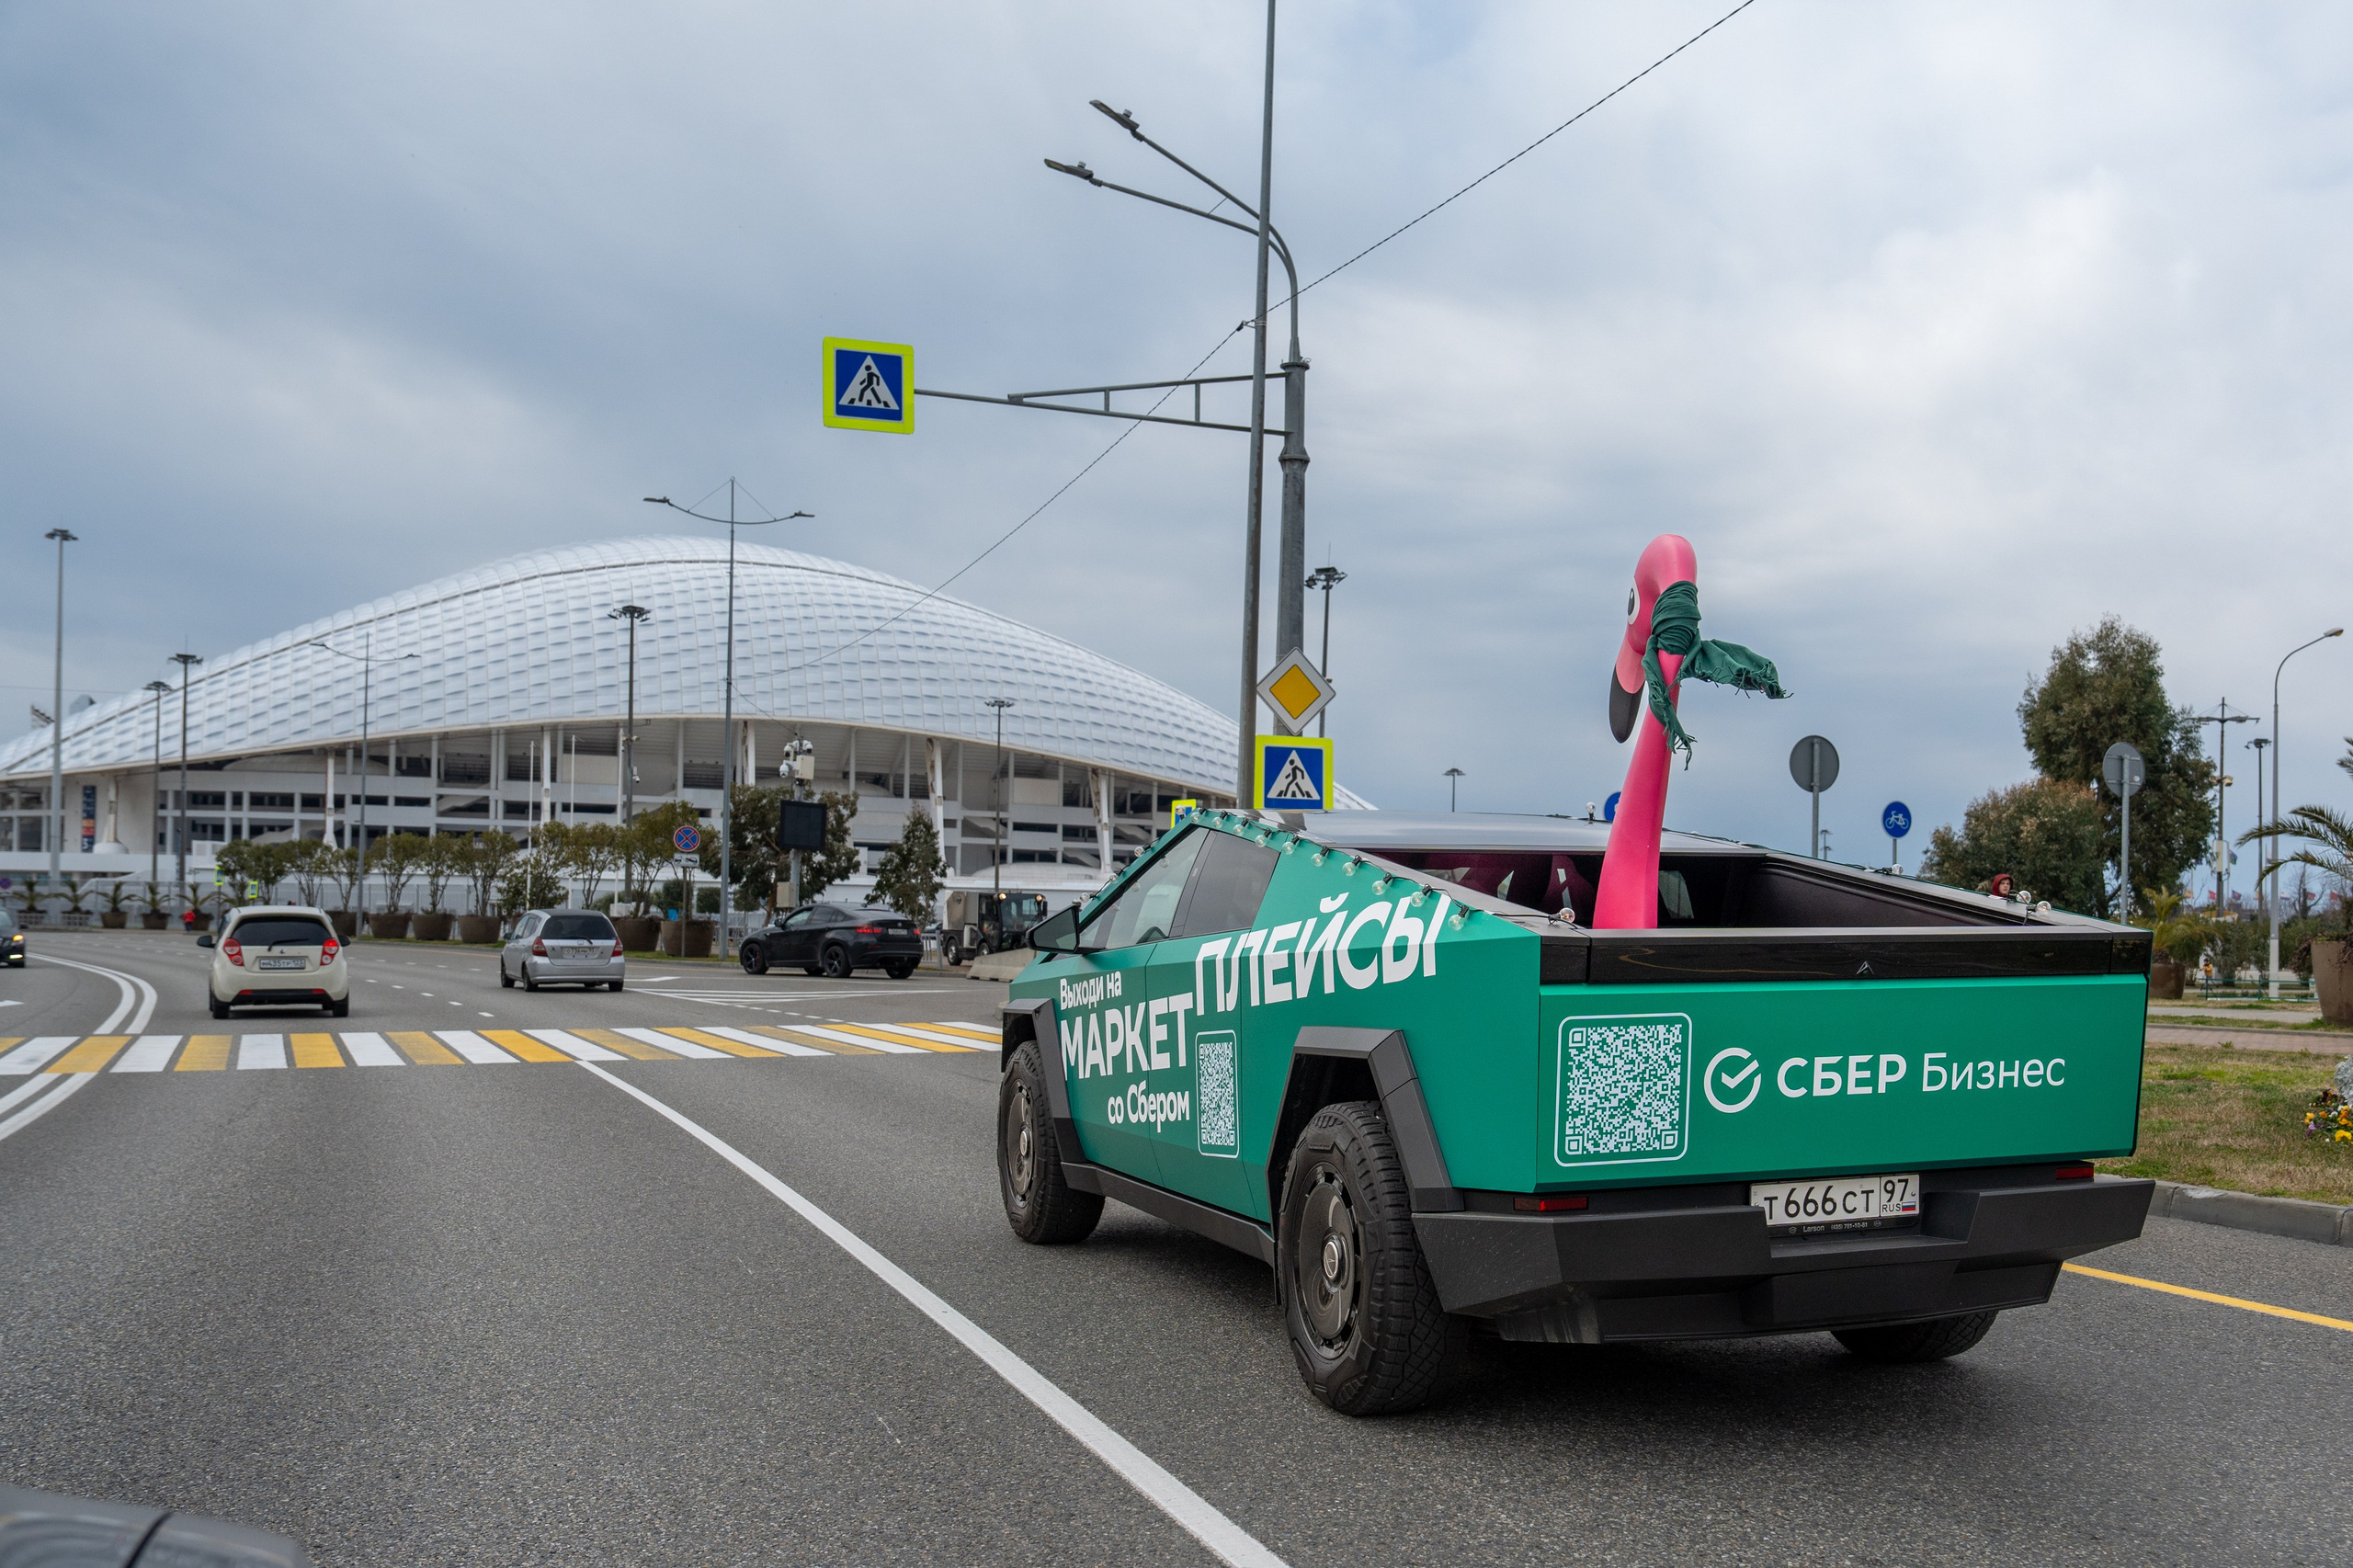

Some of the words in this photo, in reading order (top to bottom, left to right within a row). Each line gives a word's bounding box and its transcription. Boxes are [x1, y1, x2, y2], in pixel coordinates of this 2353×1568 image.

[1195, 892, 1451, 1017] ПЛЕЙСЫ
[1060, 975, 1105, 1011] Выходи
[1106, 971, 1122, 999] на
[1060, 992, 1194, 1081] МАРКЕТ
[1777, 1053, 1907, 1098] СБЕР
[1922, 1052, 2065, 1092] Бизнес
[1107, 1096, 1124, 1125] со
[1126, 1079, 1190, 1133] Сбером
[1881, 1202, 1902, 1213] RUS
[1882, 1178, 1910, 1203] 97
